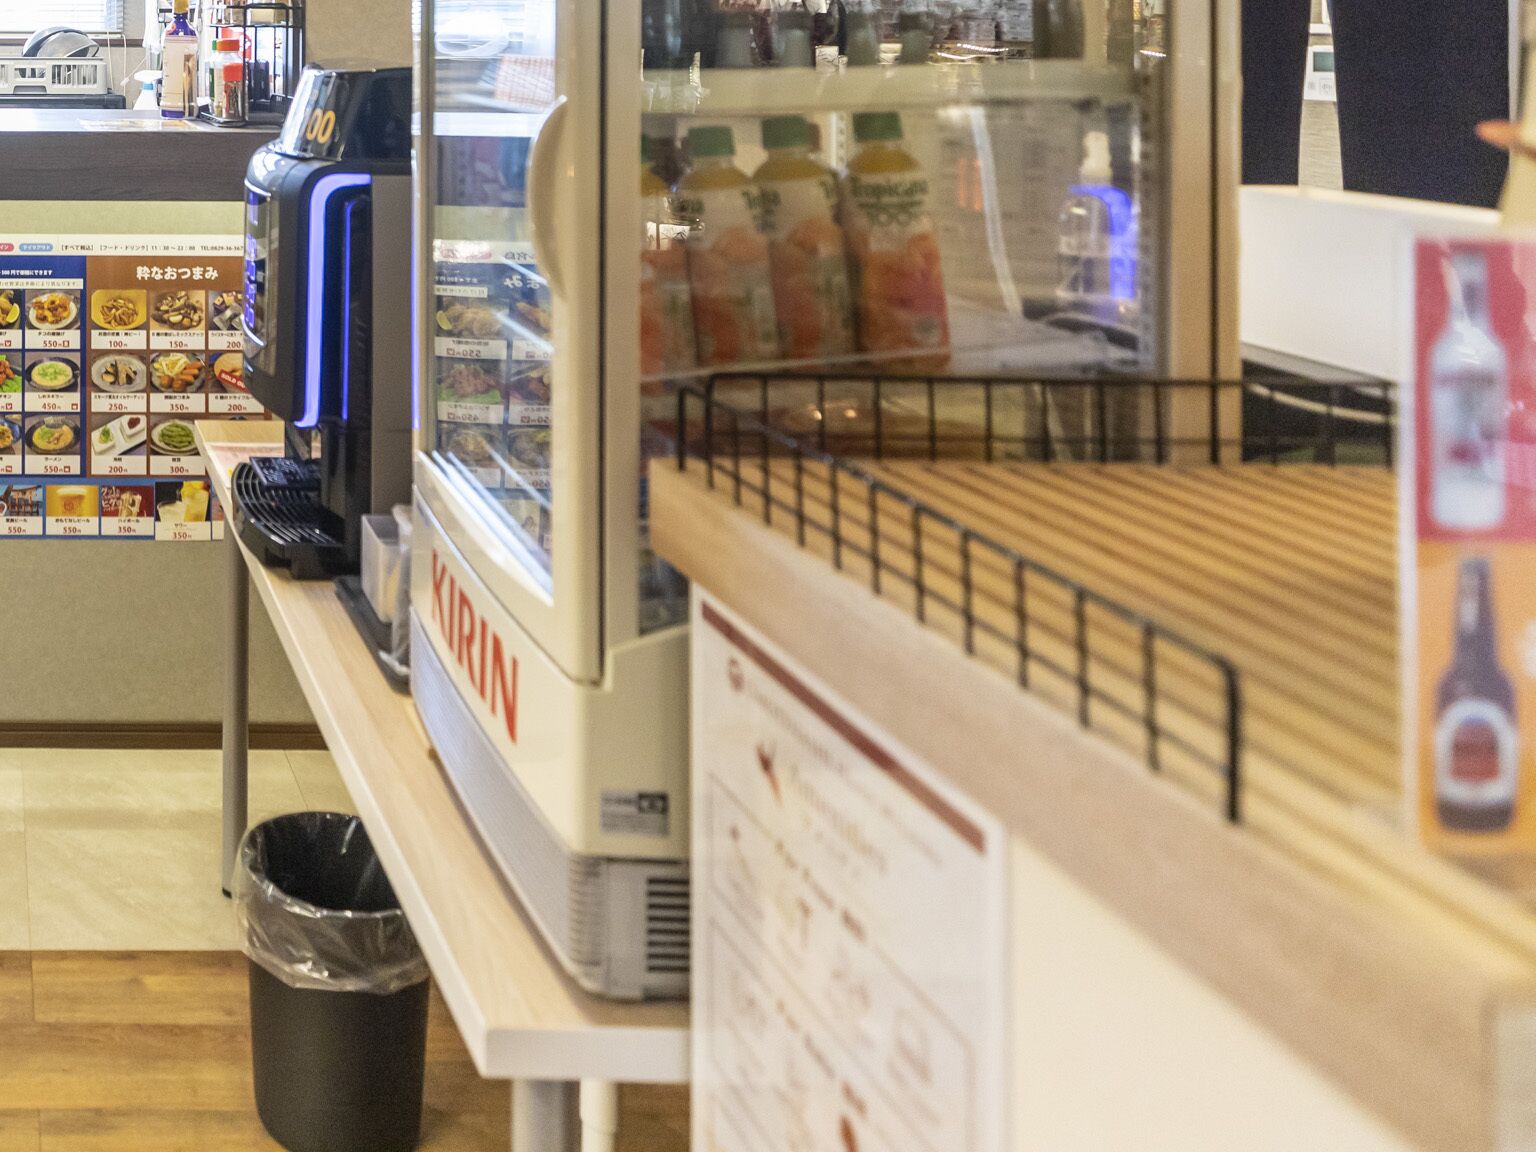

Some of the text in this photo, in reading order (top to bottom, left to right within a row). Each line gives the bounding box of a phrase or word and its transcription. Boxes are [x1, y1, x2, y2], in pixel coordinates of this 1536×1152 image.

[136, 265, 219, 280] 粋なおつまみ
[430, 546, 521, 746] KIRIN
